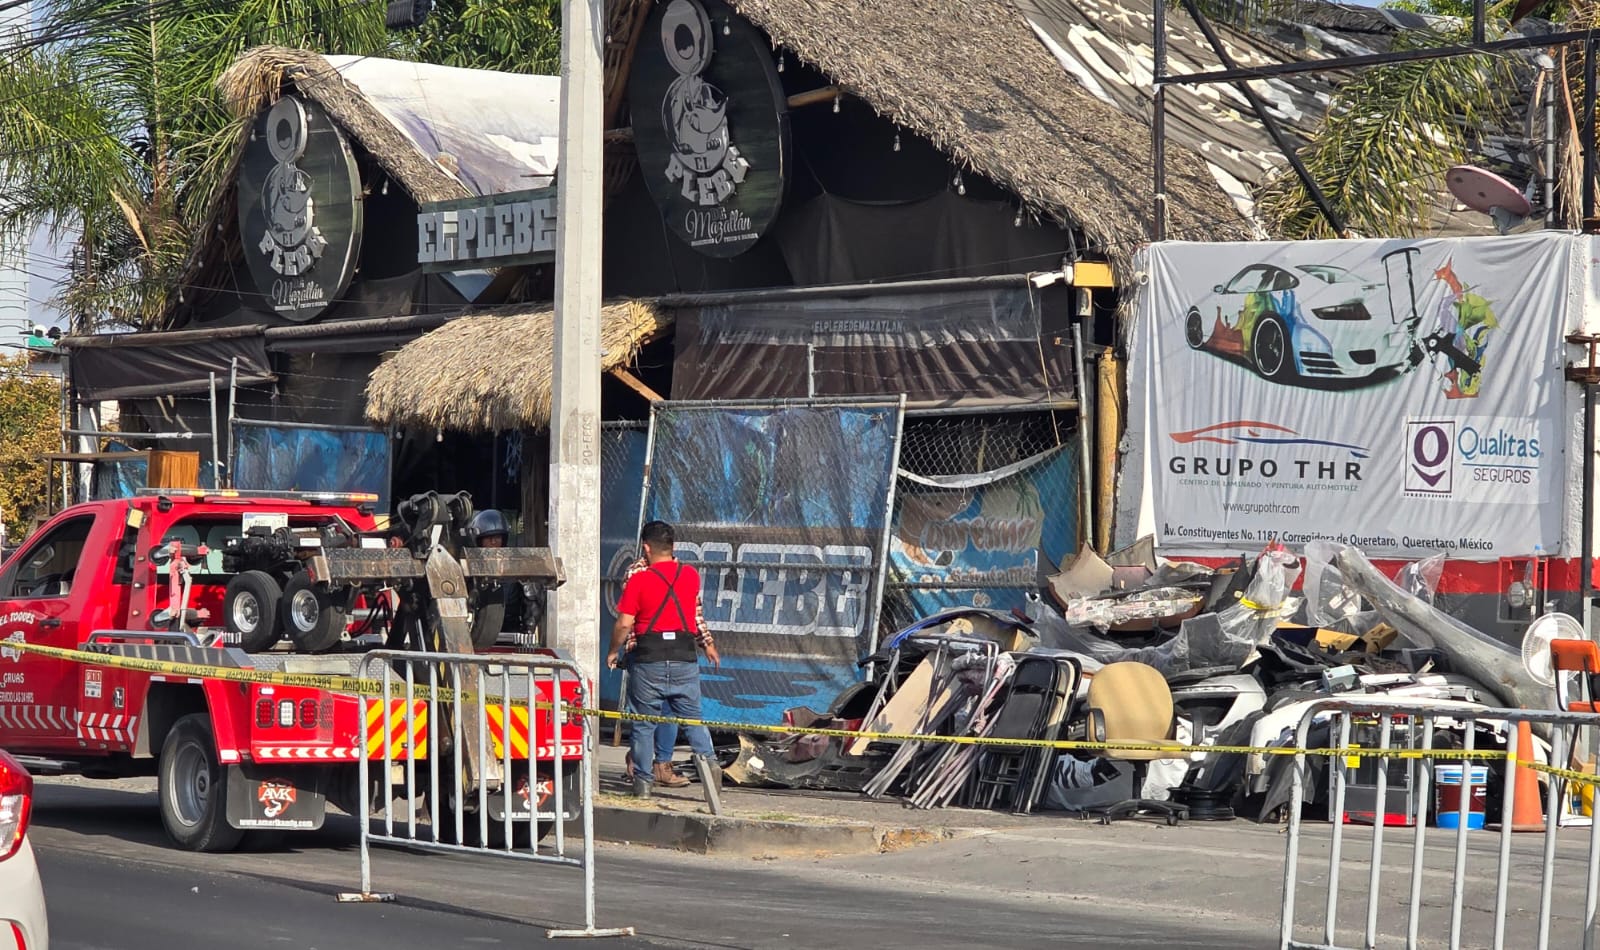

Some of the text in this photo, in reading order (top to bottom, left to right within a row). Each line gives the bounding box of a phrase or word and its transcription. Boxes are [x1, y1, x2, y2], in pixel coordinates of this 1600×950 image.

[664, 146, 752, 206] PLEBE
[417, 198, 557, 263] EL PLEBE
[1457, 426, 1540, 461] Qualitas
[1168, 456, 1363, 481] GRUPO THR
[1473, 467, 1532, 484] SEGUROS
[1179, 479, 1209, 487] CENTRO
[1223, 480, 1262, 488] LAMINADO
[1272, 482, 1304, 490] PINTURA
[1306, 483, 1358, 492] AUTOMOTRIZ
[1222, 501, 1300, 515] www.grupothr.com
[1164, 523, 1176, 536] Av.
[1177, 525, 1239, 541] Constituyentes
[1241, 529, 1255, 540] No.
[1336, 533, 1348, 545] de
[1350, 534, 1398, 548] Queretaro,
[1402, 536, 1458, 550] Querertaro,
[1459, 536, 1493, 551] México
[3, 672, 25, 684] GRUAS
[259, 787, 295, 802] AMK
